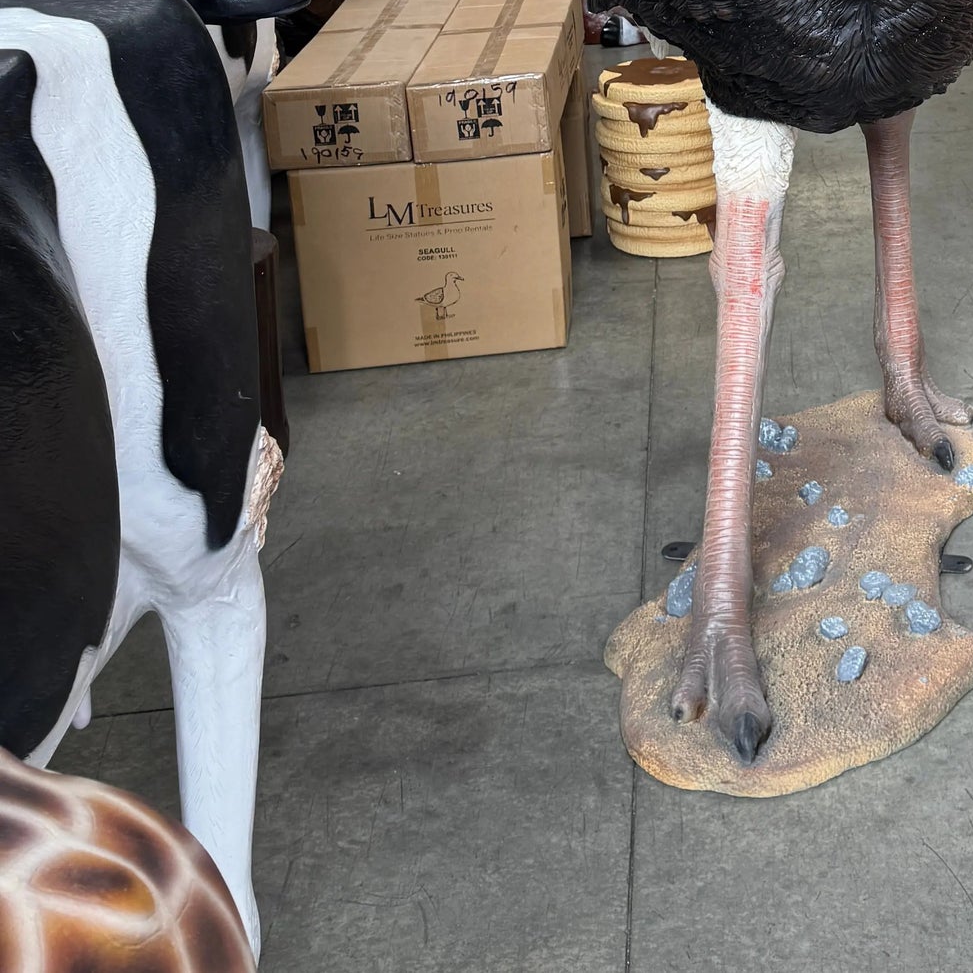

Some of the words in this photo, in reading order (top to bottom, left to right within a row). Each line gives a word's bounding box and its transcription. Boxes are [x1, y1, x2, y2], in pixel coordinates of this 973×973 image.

[438, 80, 518, 107] 190159
[300, 146, 364, 164] 190159
[416, 202, 494, 218] Treasures
[418, 246, 456, 256] SEAGULL
[441, 329, 477, 338] PHILIPPINES
